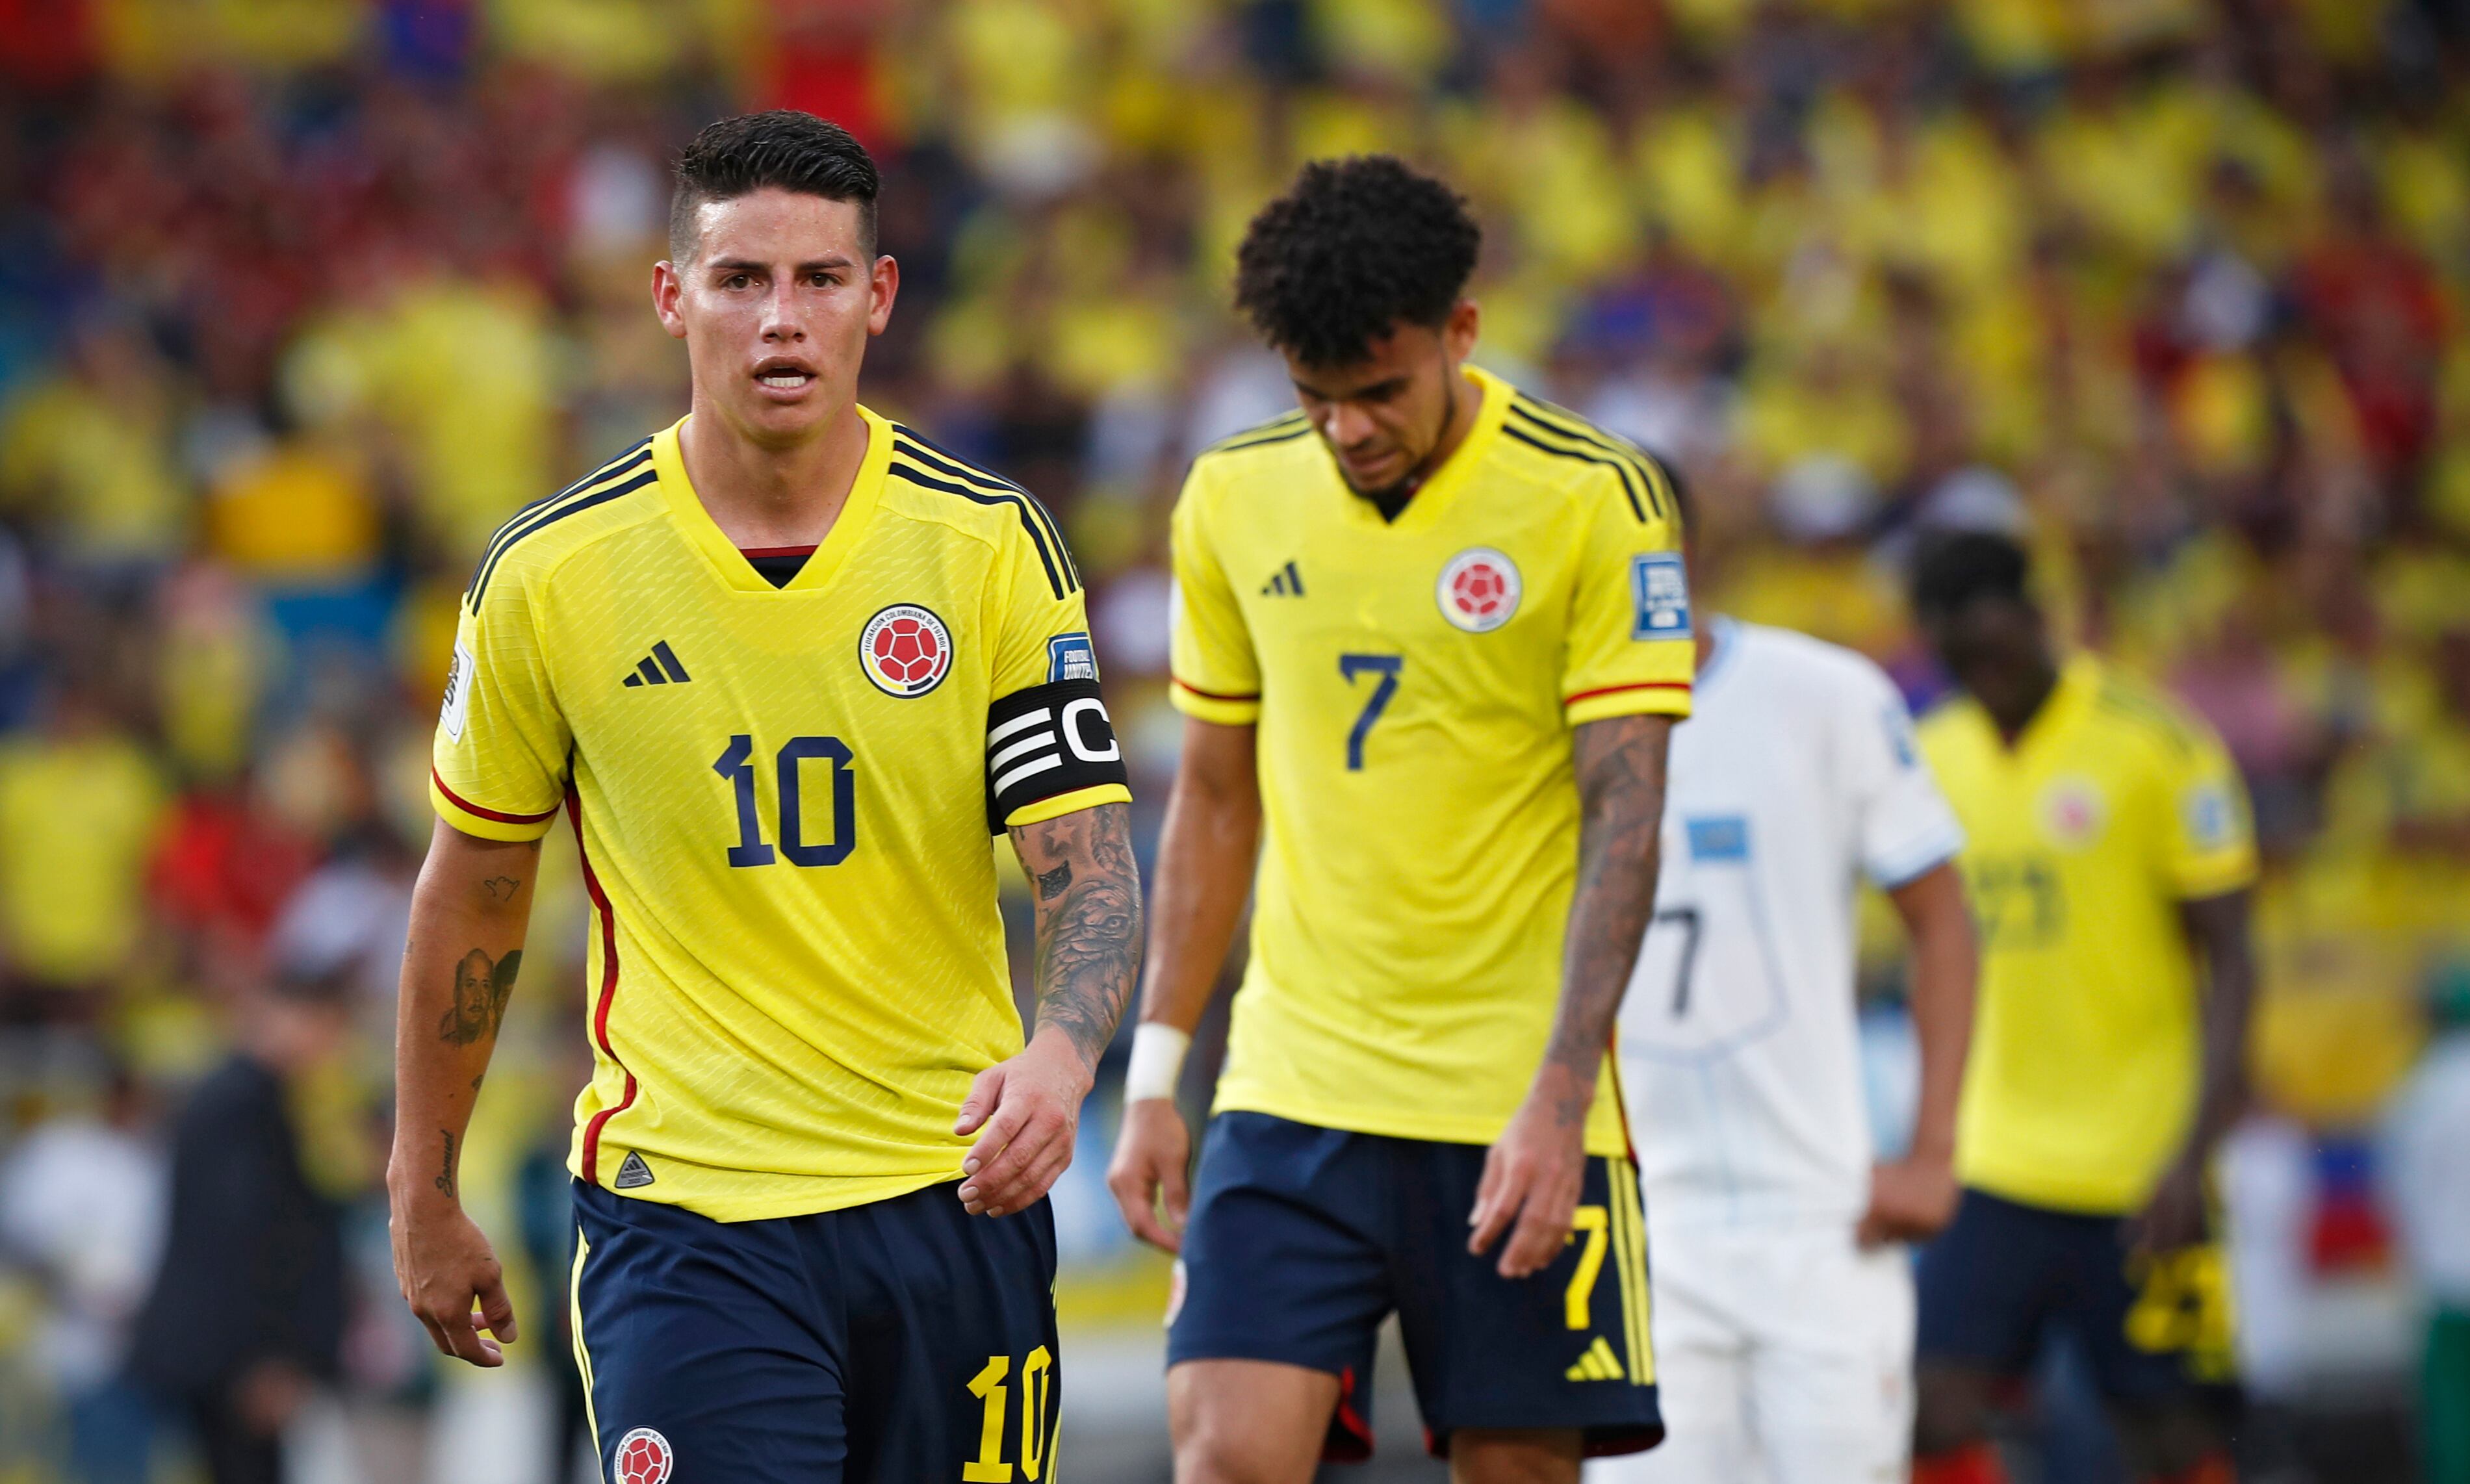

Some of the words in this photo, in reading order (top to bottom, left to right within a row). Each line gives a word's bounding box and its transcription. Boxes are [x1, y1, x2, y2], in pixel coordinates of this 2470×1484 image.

[1061, 697, 1120, 762] C
[1339, 654, 1404, 772] 7
[712, 734, 856, 867] 10
[1656, 903, 1701, 1019] 7
[1563, 1205, 1610, 1331] 7
[962, 1344, 1052, 1483] 10
